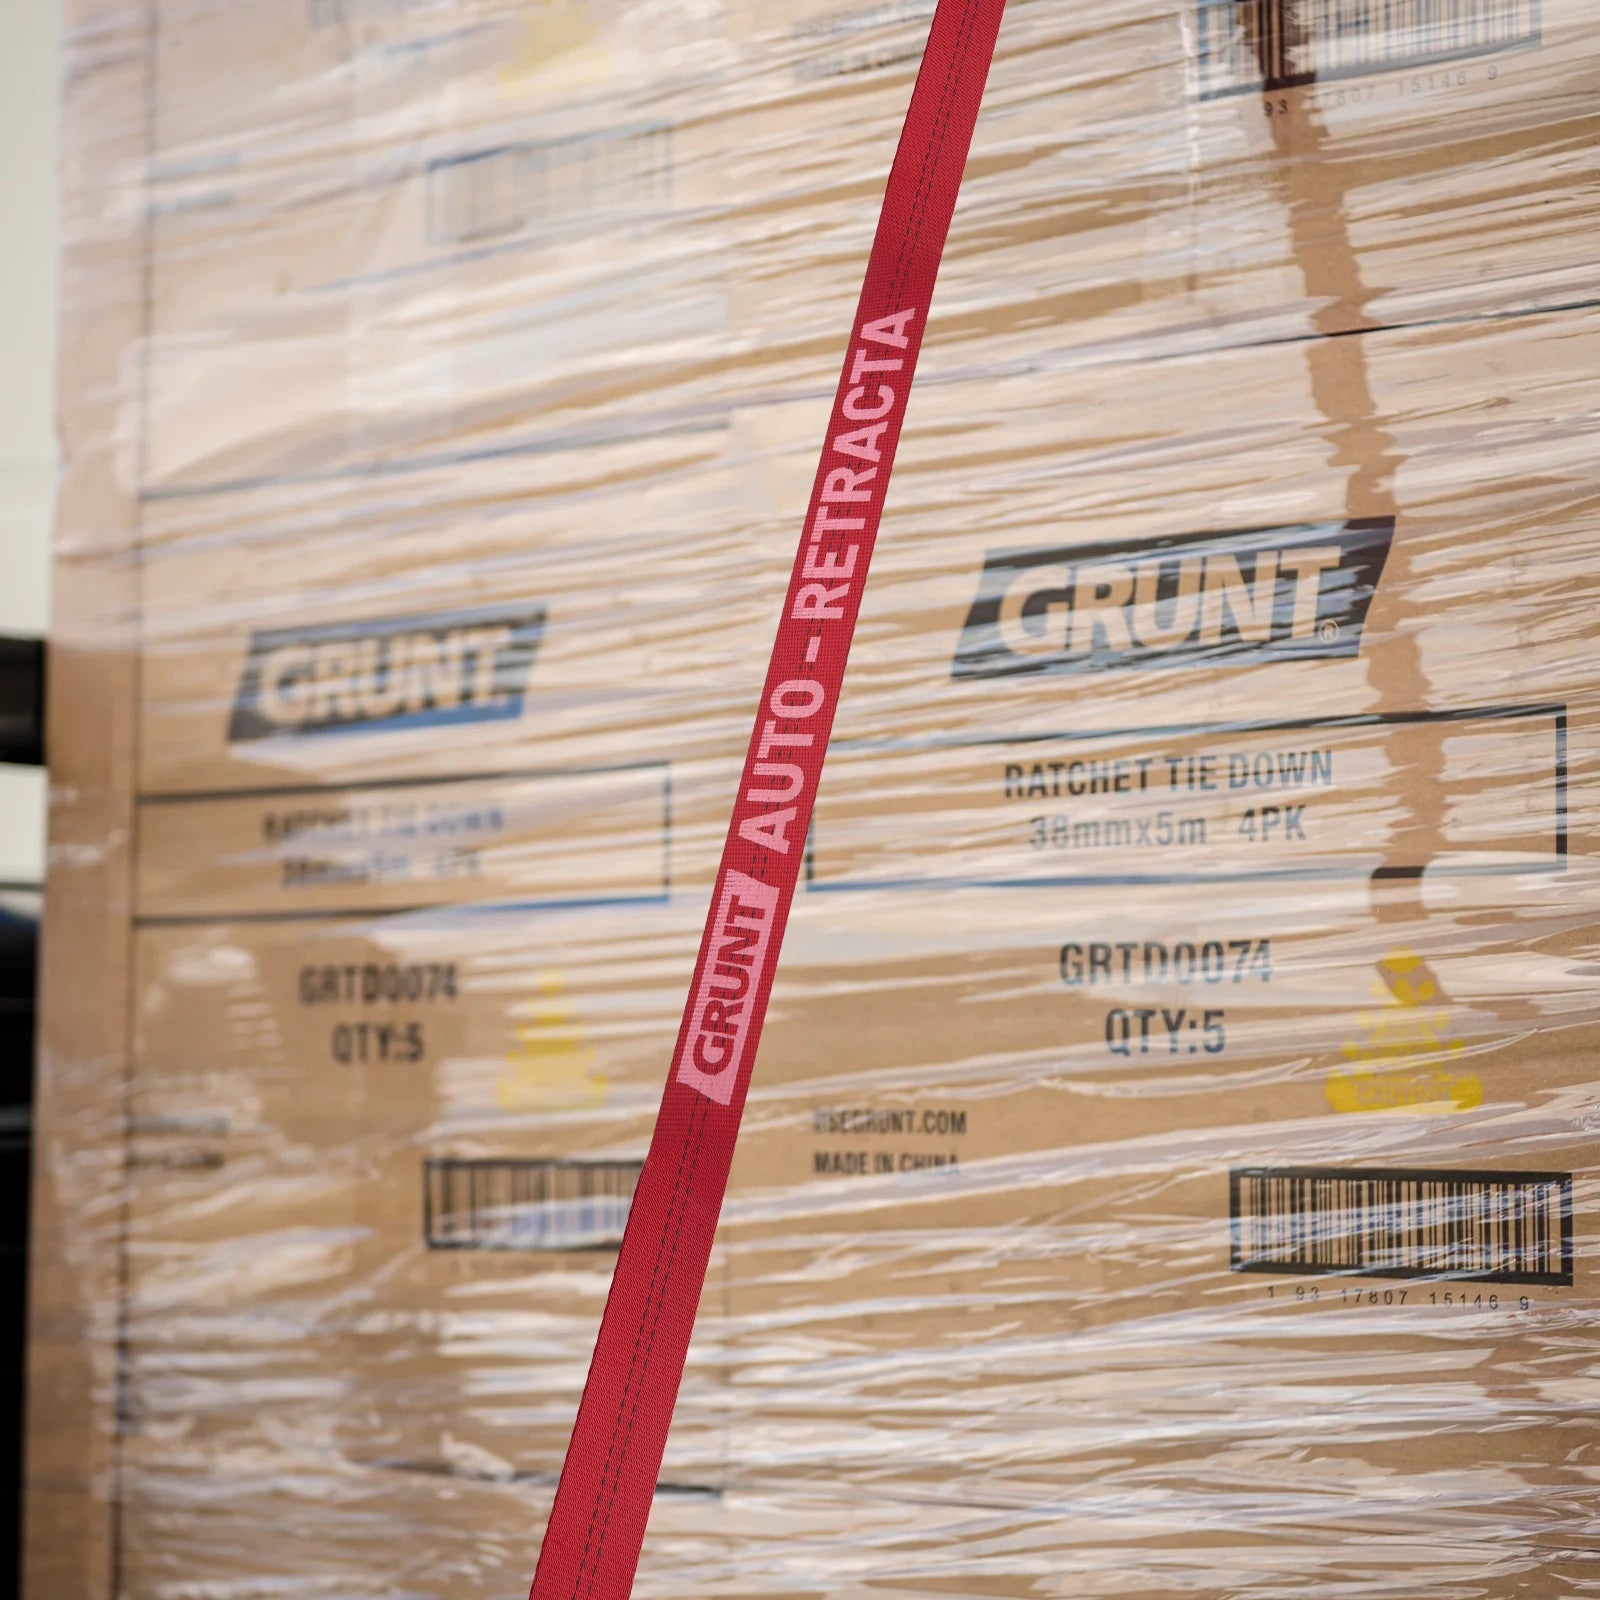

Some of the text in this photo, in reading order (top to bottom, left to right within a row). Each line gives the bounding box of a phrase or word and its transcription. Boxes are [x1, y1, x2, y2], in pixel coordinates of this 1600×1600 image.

[1264, 100, 1288, 117] 93
[1487, 63, 1499, 81] 9
[693, 895, 767, 1076] GRUNT
[738, 678, 825, 854] AUTO
[791, 307, 916, 620] RETRACTA
[1005, 749, 1333, 798] RATCHET TIE DOWN
[1028, 804, 1307, 849] 38mmx5m 4PK
[1059, 939, 1273, 986] GRTD0074
[331, 1021, 425, 1065] QTY:5
[1104, 1008, 1226, 1056] QTY:5
[813, 1152, 869, 1174] MADE
[874, 1153, 894, 1173] IN
[1267, 1286, 1530, 1311] 1 93 17807 15146 9
